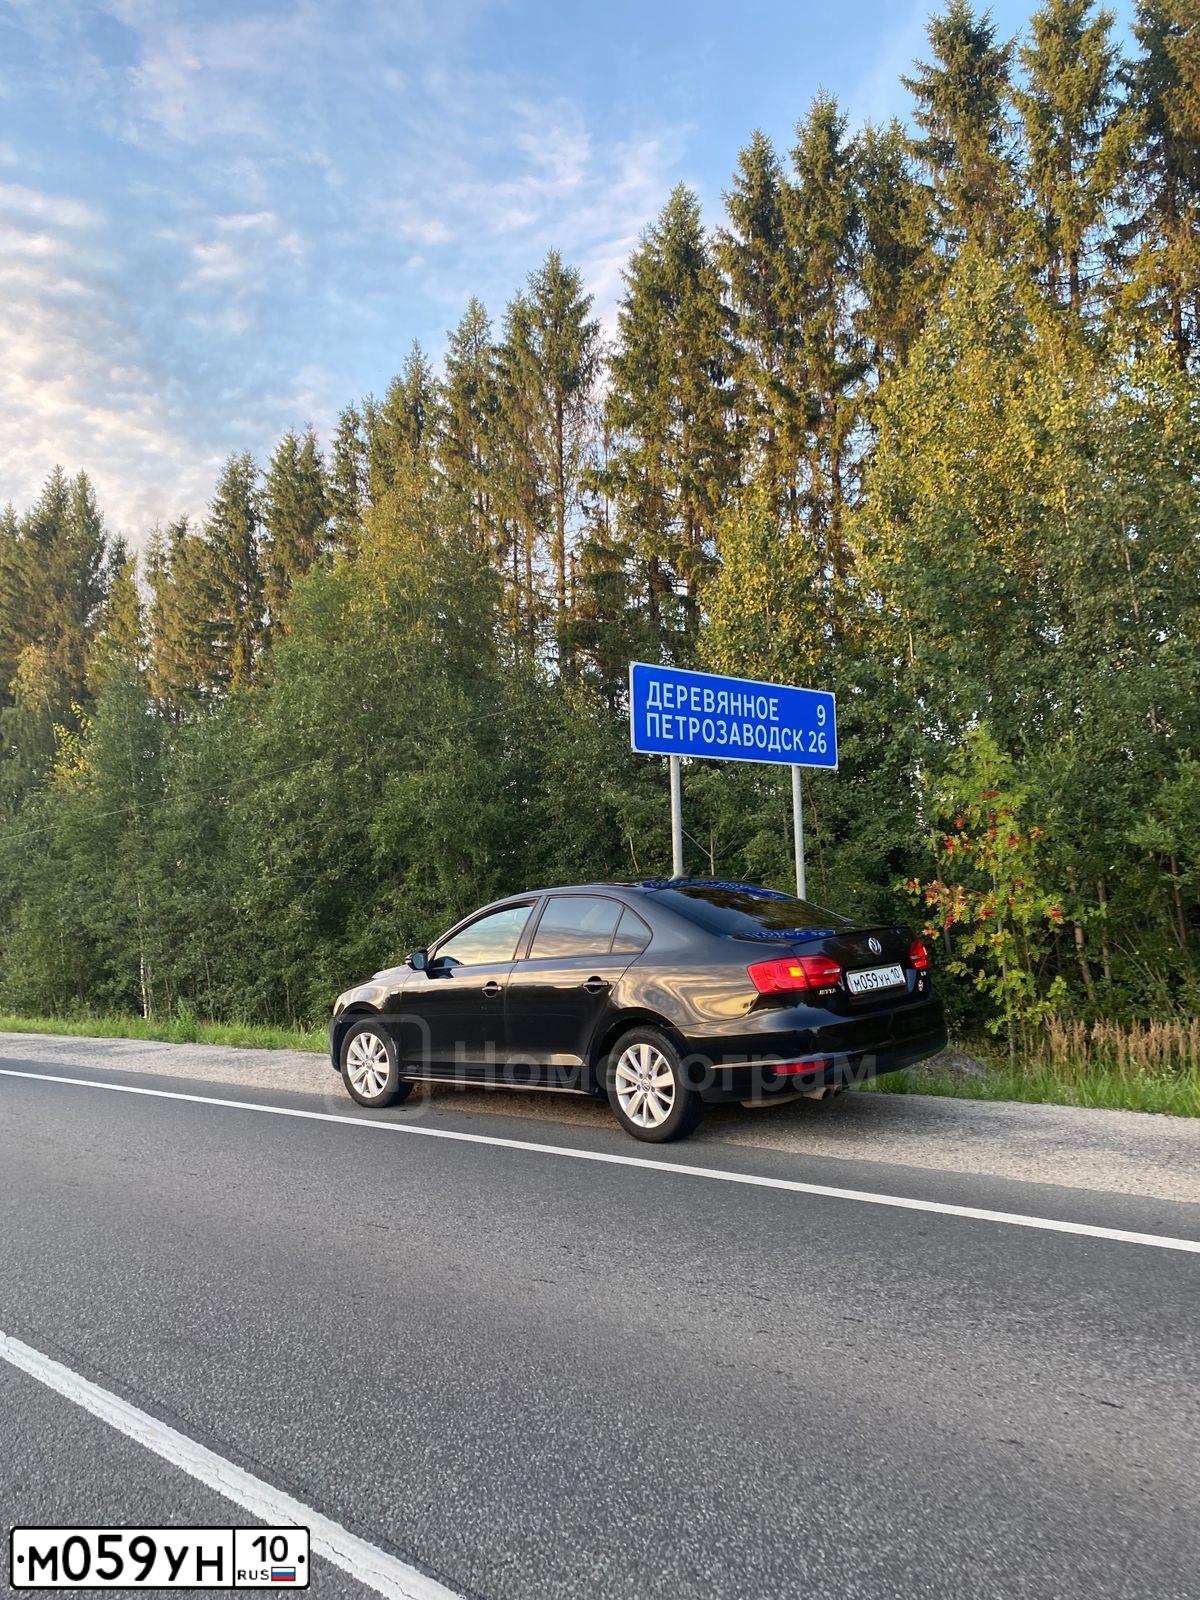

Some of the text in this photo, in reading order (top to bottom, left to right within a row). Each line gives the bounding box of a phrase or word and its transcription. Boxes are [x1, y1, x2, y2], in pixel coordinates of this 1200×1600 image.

[646, 681, 826, 727] ДЕРЕВЯННОЕ 9
[646, 713, 828, 753] ПЕТРОЗАВОДСК 26
[853, 968, 899, 990] М059УН 10
